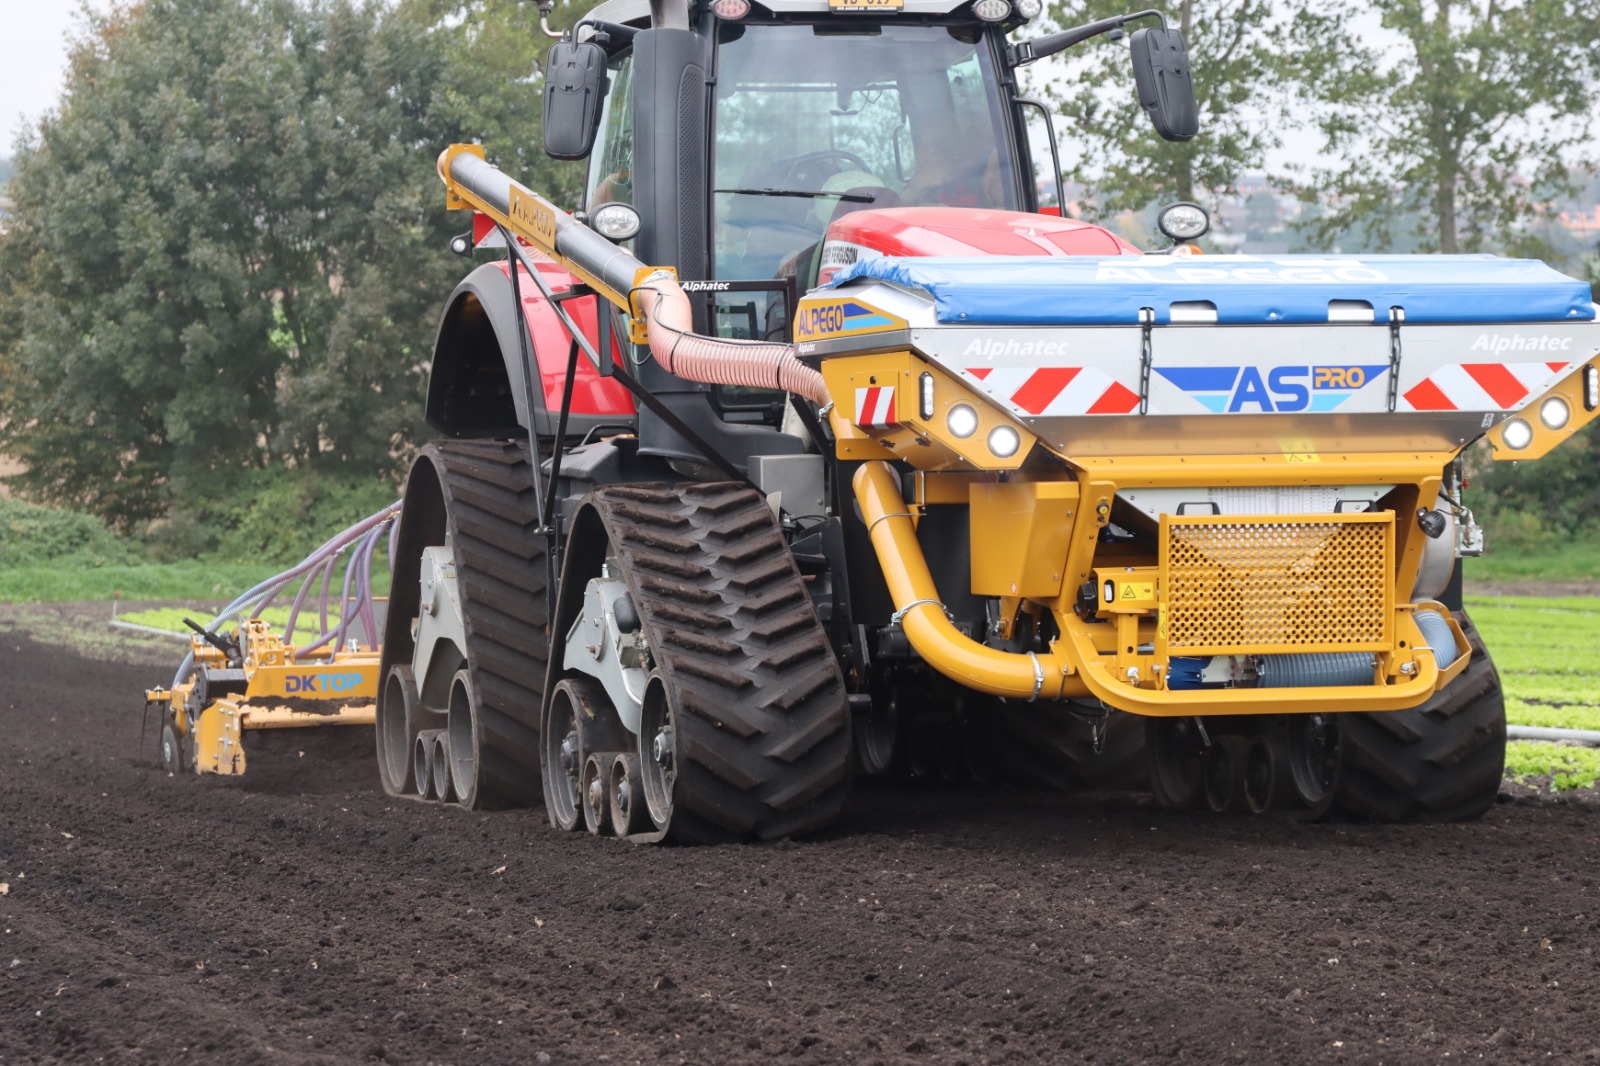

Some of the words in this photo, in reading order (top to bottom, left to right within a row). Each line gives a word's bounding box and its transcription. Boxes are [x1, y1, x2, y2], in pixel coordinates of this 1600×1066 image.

[1095, 266, 1389, 284] ALPEGO
[681, 281, 730, 293] Alphatec
[798, 304, 843, 336] ALPEGO
[963, 339, 1070, 361] Alphatec
[1470, 333, 1573, 356] Alphatec
[1228, 366, 1309, 412] AS
[1315, 367, 1365, 388] PRO
